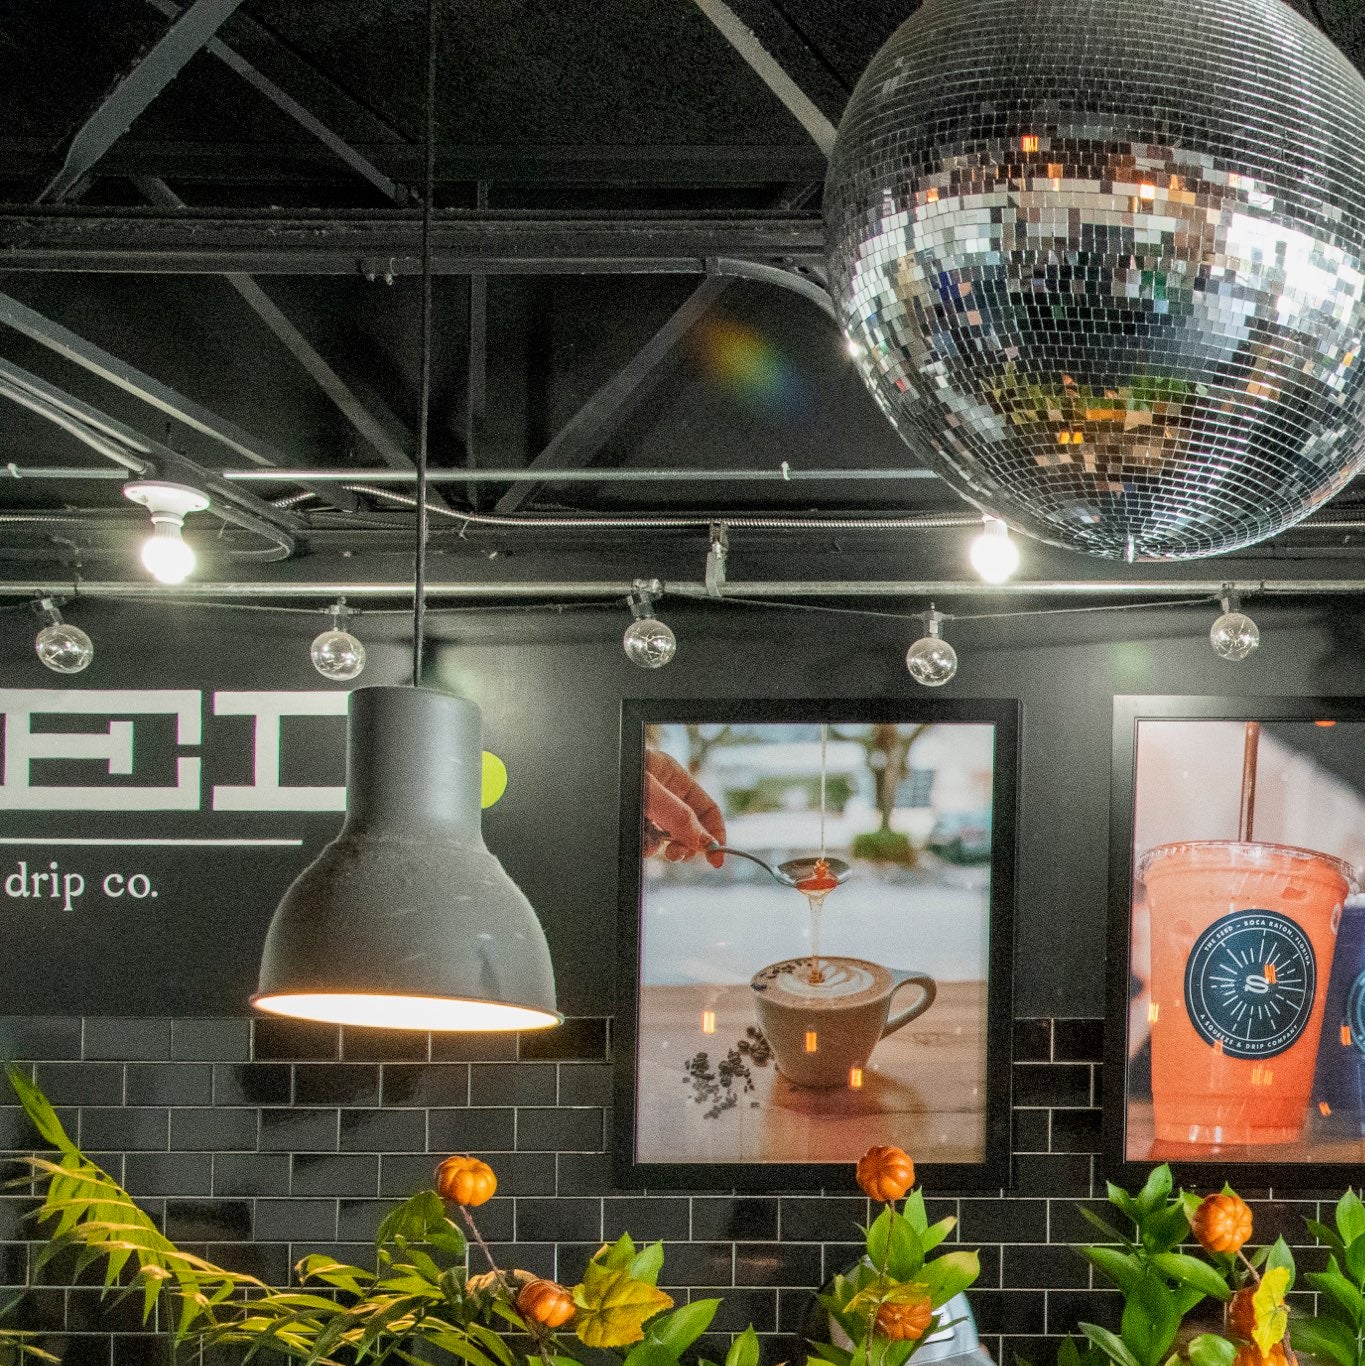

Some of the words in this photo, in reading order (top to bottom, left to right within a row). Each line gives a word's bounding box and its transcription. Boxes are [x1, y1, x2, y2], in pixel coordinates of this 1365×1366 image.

[5, 862, 85, 910] drip
[103, 868, 158, 898] co.
[1216, 925, 1234, 939] SEED
[1244, 918, 1265, 927] BOCA
[1294, 936, 1311, 966] FLORIDA
[1267, 1024, 1299, 1048] COMPANY
